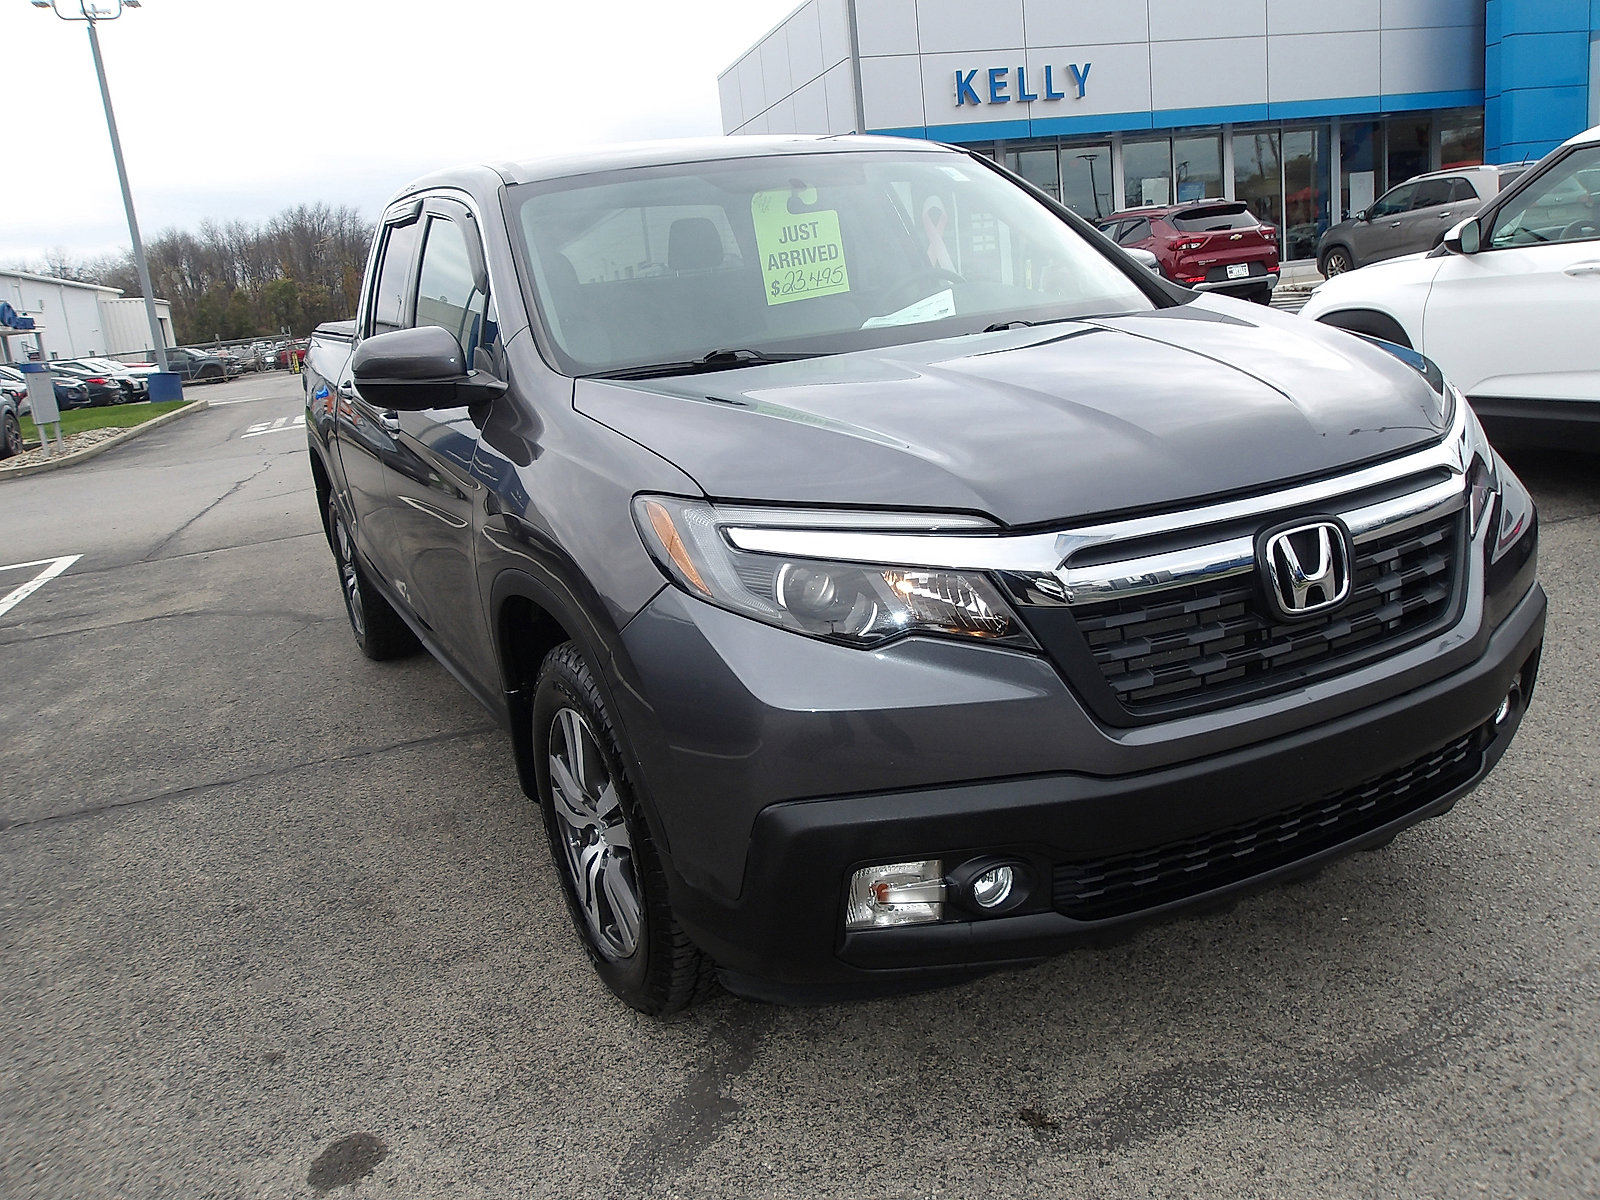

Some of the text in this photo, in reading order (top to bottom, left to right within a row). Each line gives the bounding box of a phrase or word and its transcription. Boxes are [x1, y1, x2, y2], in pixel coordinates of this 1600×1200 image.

[954, 62, 1092, 107] KELLY
[779, 221, 819, 244] JUST
[768, 243, 839, 271] ARRIVED
